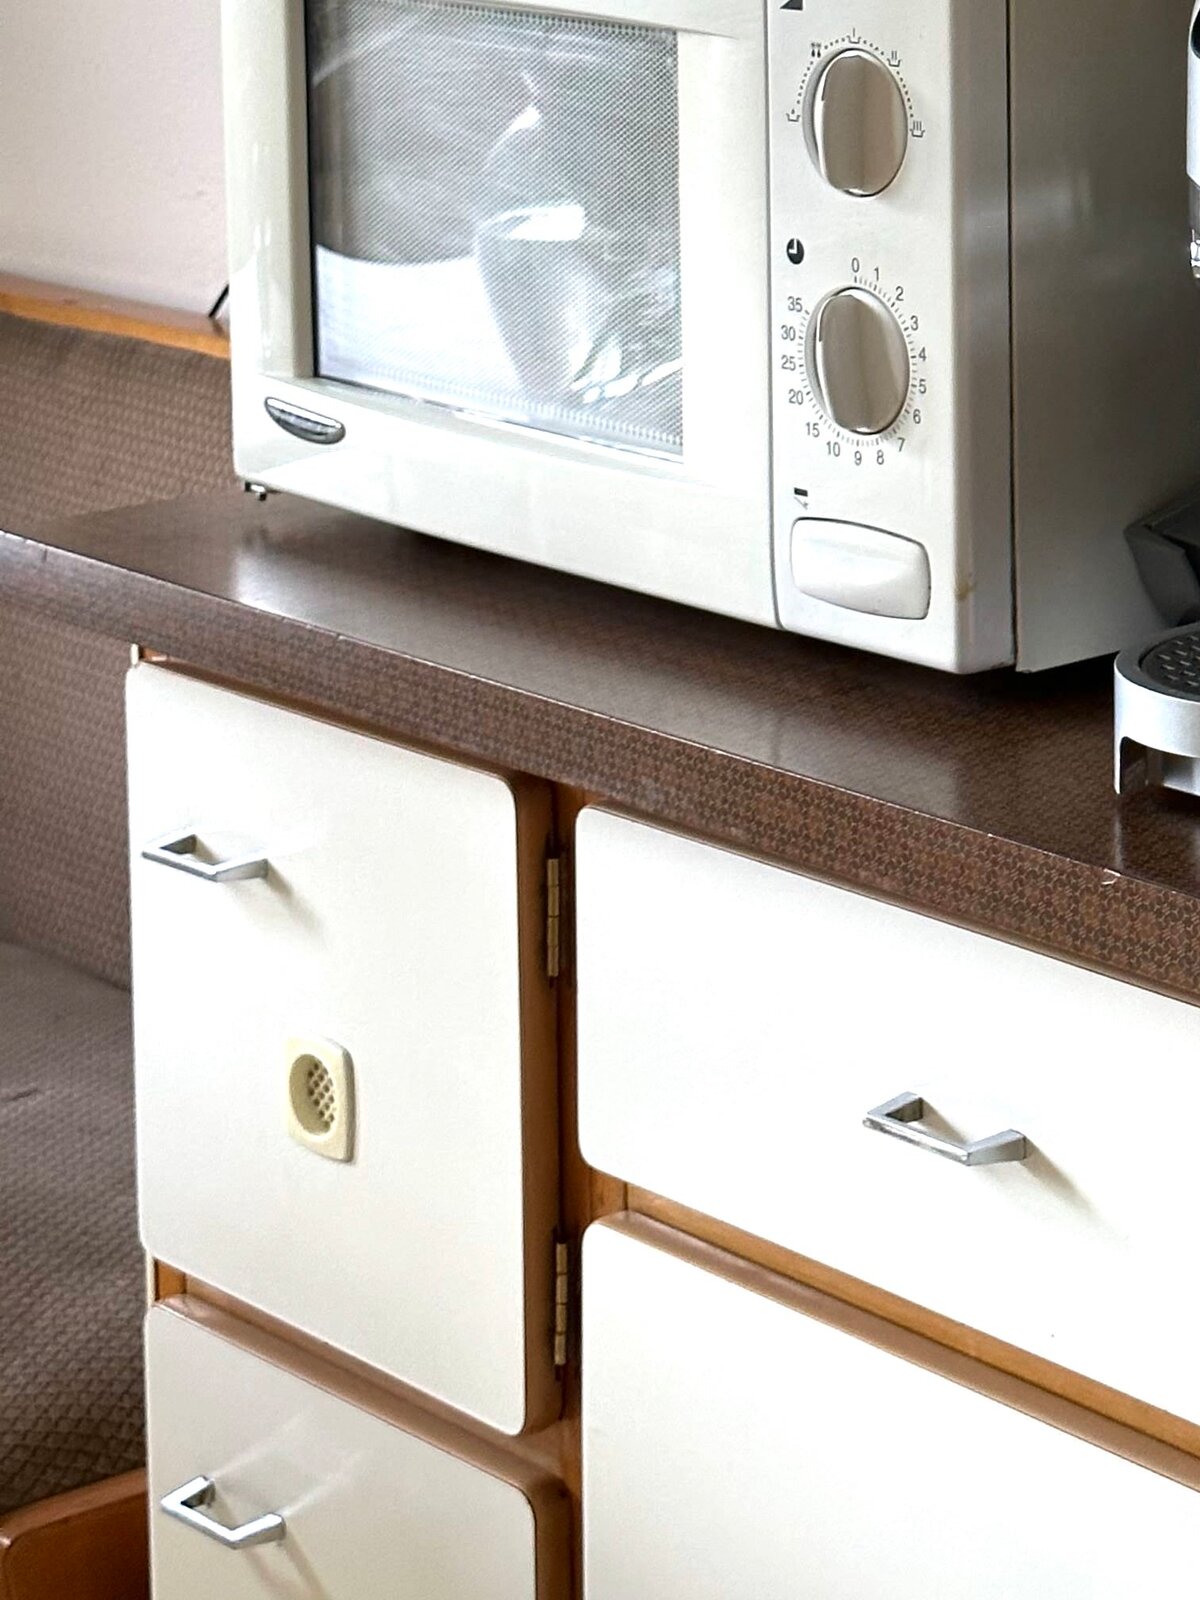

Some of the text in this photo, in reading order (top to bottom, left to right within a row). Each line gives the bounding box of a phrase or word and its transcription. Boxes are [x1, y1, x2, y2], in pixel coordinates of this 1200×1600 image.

[851, 258, 860, 273] 0
[874, 267, 880, 281] 1
[896, 286, 904, 301] 2
[788, 297, 803, 313] 35
[910, 316, 919, 331] 3
[781, 325, 796, 341] 30
[918, 347, 927, 361] 4
[781, 355, 796, 370] 25
[918, 379, 927, 394] 5
[788, 390, 804, 405] 20
[913, 409, 922, 424] 6
[805, 422, 820, 438] 15
[826, 441, 841, 457] 10
[898, 437, 906, 451] 7
[854, 450, 862, 466] 9
[876, 449, 885, 465] 8
